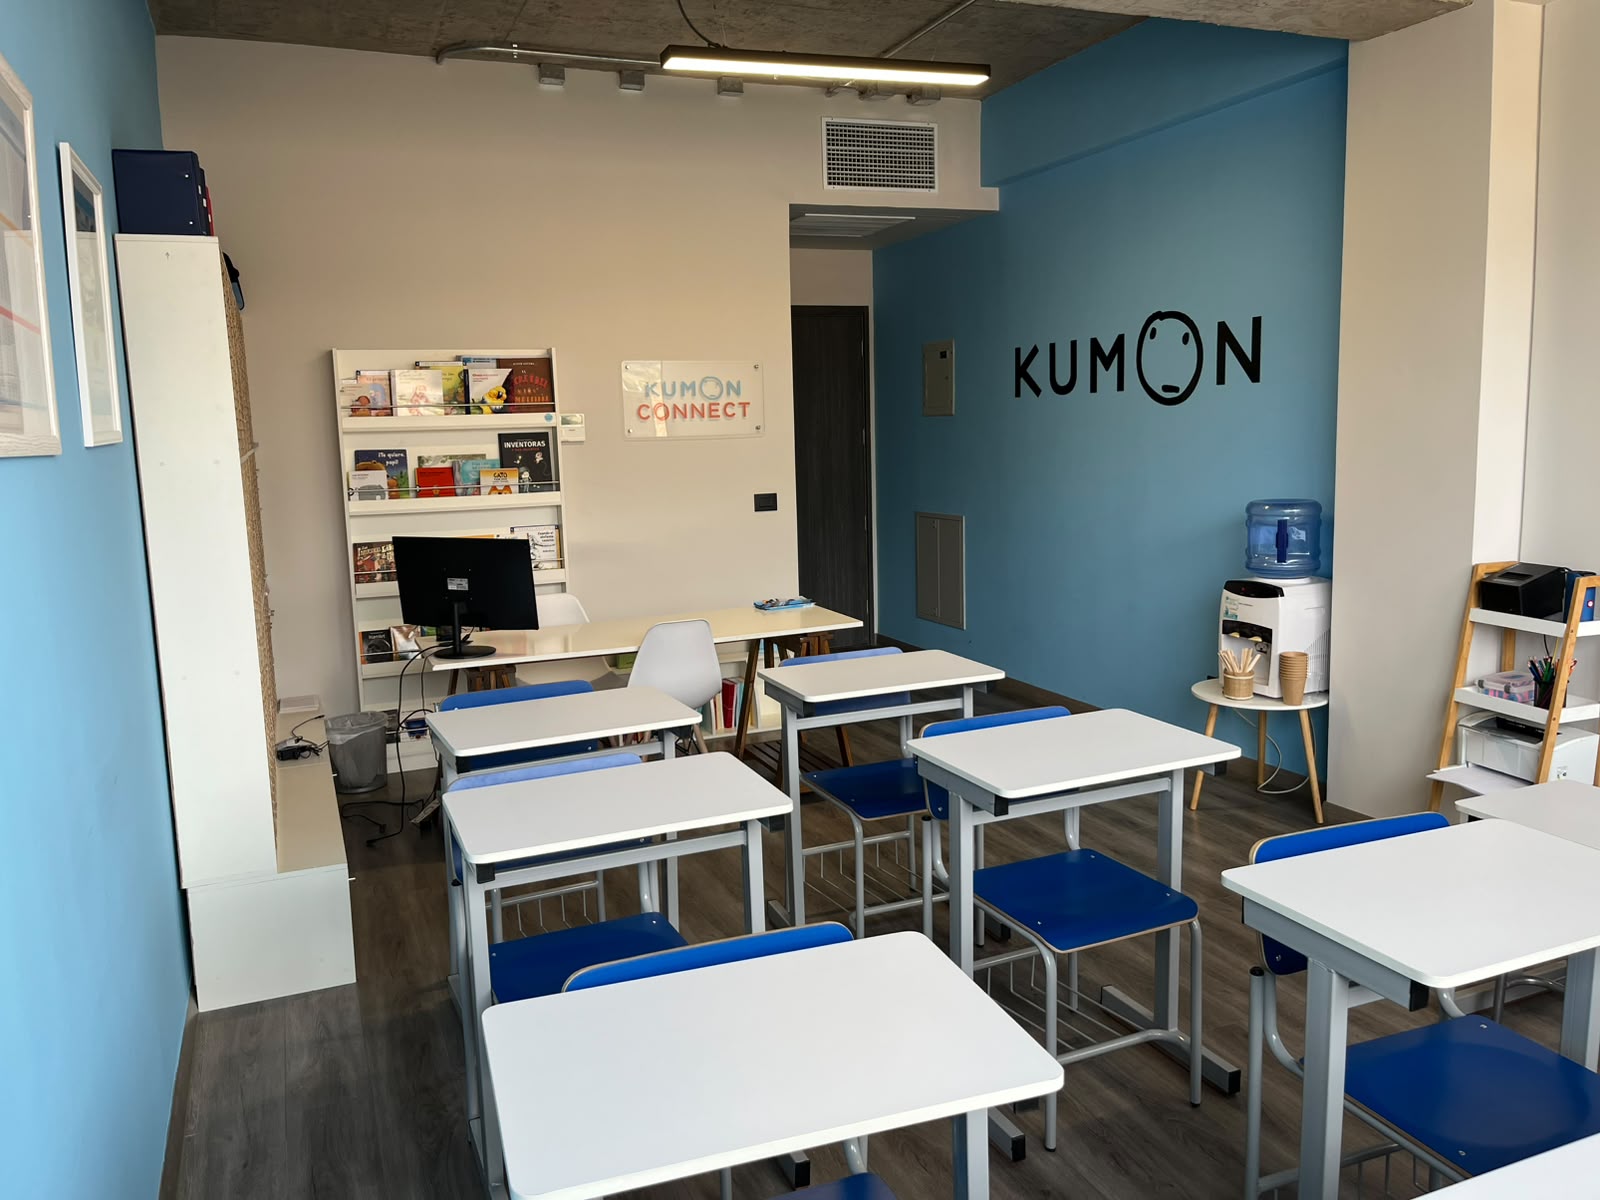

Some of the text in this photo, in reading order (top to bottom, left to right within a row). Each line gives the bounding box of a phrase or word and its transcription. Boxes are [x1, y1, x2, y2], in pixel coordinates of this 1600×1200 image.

[1014, 310, 1263, 407] KUMON
[644, 376, 742, 401] KUMON
[637, 402, 751, 421] CONNECT
[503, 440, 546, 449] INVENTORAS
